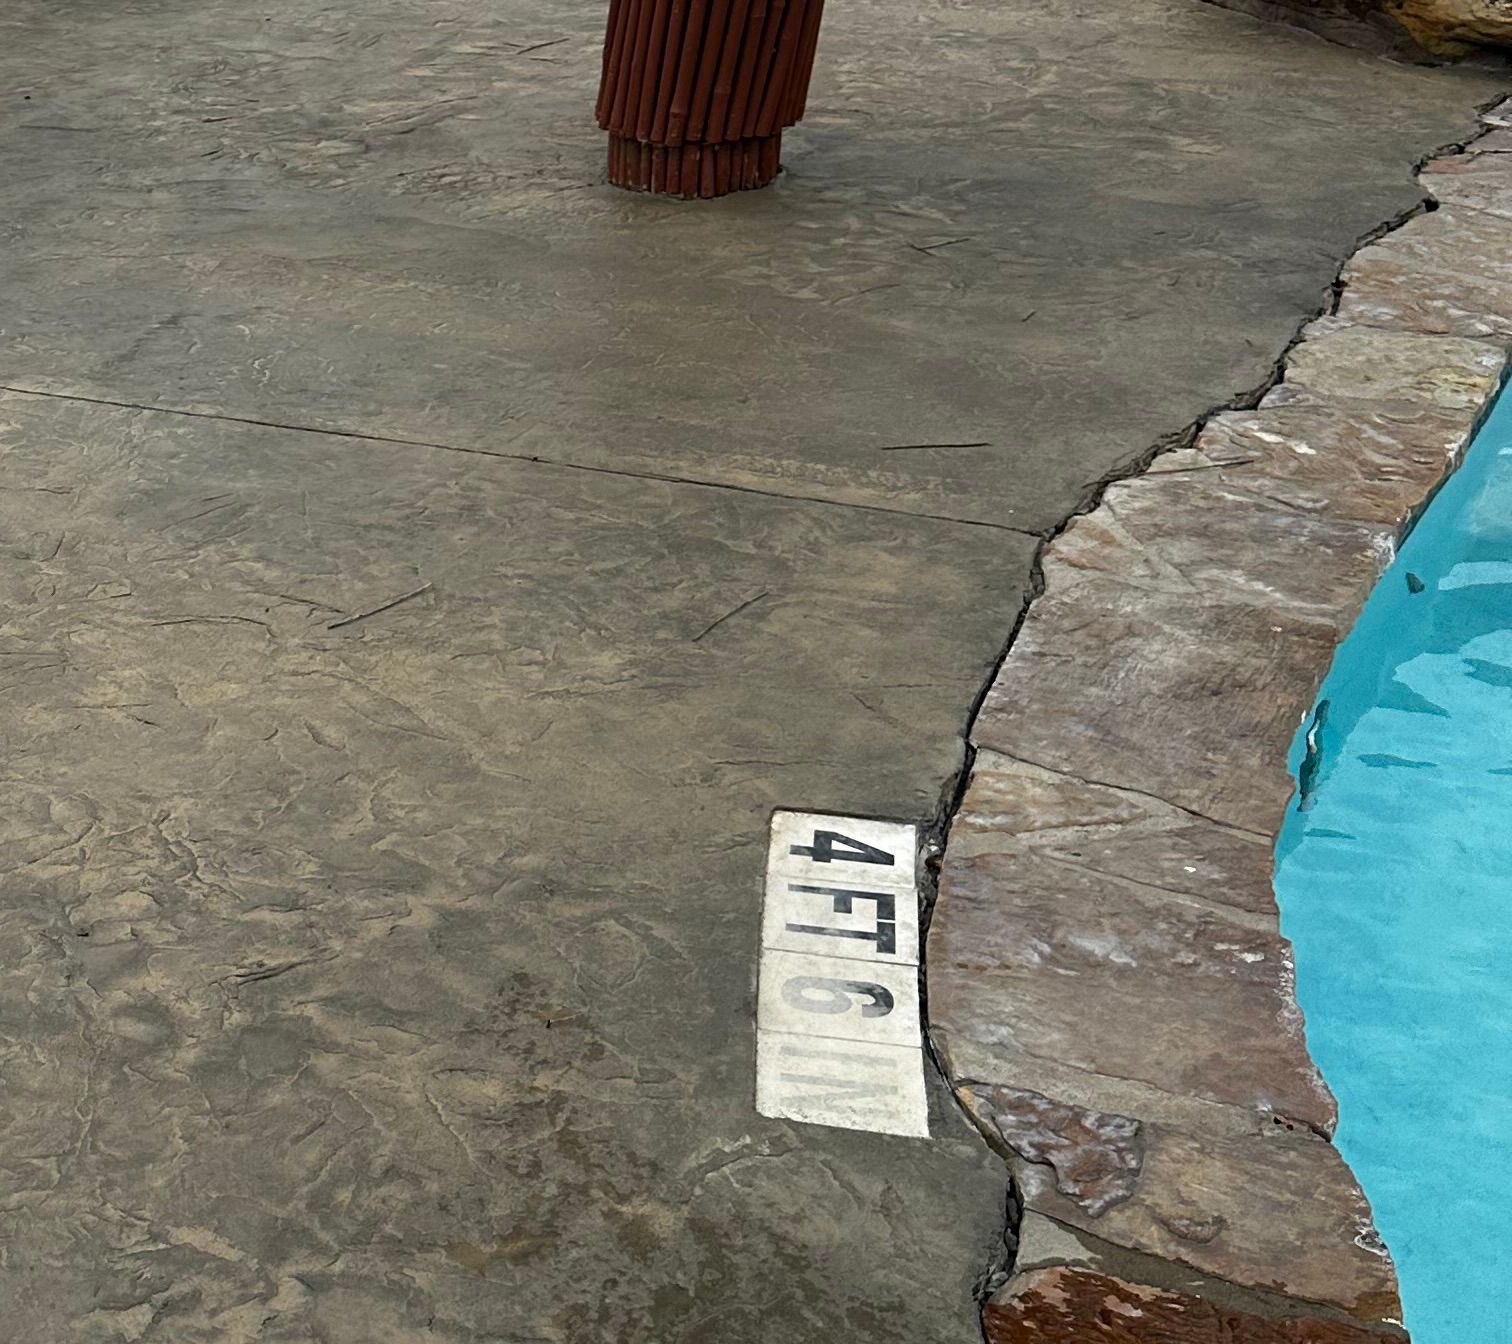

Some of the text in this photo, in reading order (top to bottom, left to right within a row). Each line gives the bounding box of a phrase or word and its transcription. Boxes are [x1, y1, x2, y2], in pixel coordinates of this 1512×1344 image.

[789, 829, 895, 866] 4
[786, 883, 896, 955] FT
[780, 975, 895, 1019] 6
